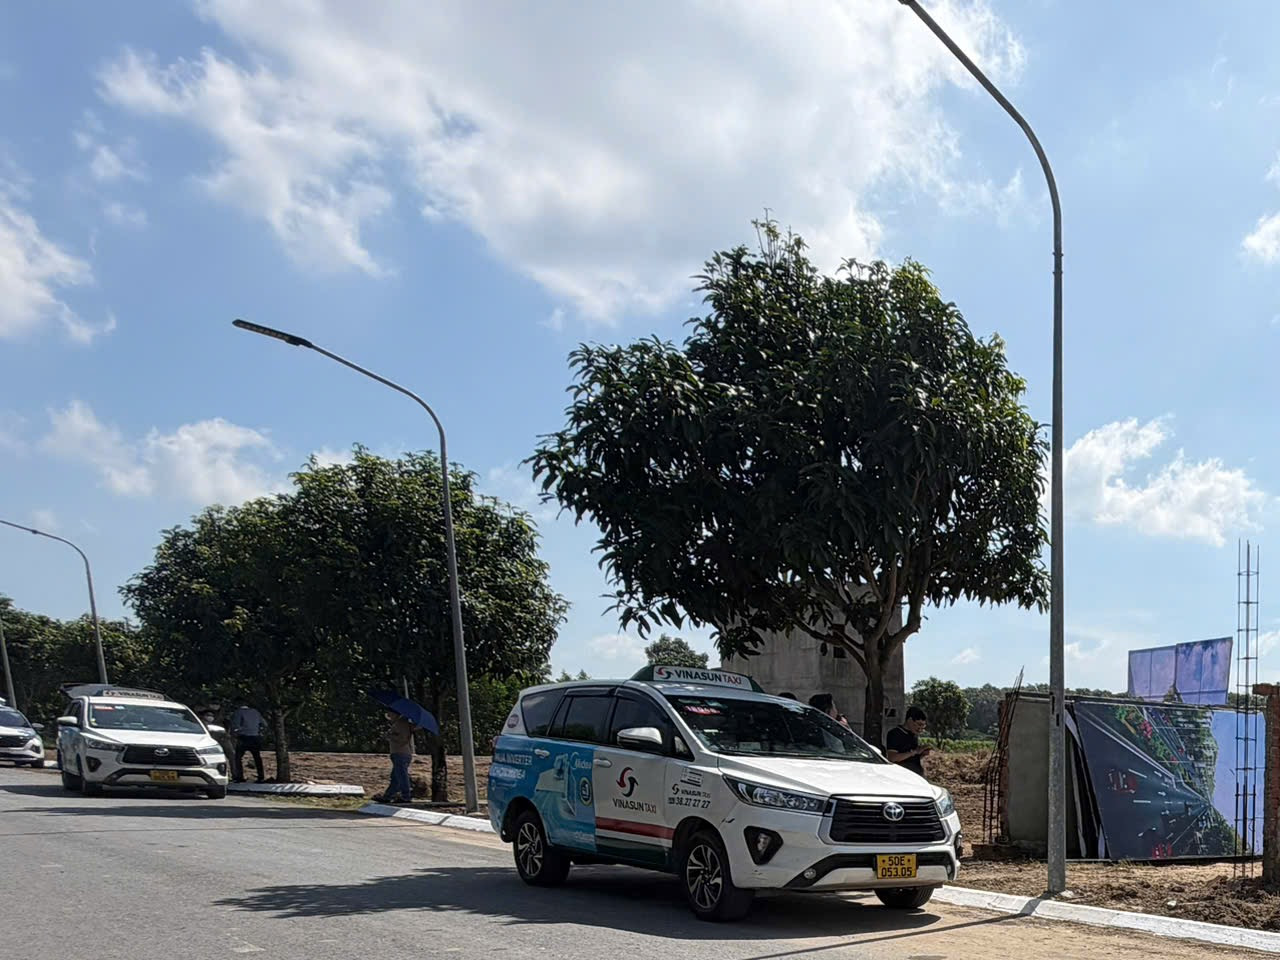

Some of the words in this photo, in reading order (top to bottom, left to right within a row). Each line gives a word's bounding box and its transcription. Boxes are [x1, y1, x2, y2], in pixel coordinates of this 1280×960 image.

[675, 670, 721, 682] VINASUN
[721, 674, 742, 685] TAXI
[612, 798, 644, 812] VINASUN
[645, 803, 657, 814] TAXI
[888, 856, 905, 866] 50E
[881, 867, 912, 877] 053.05
